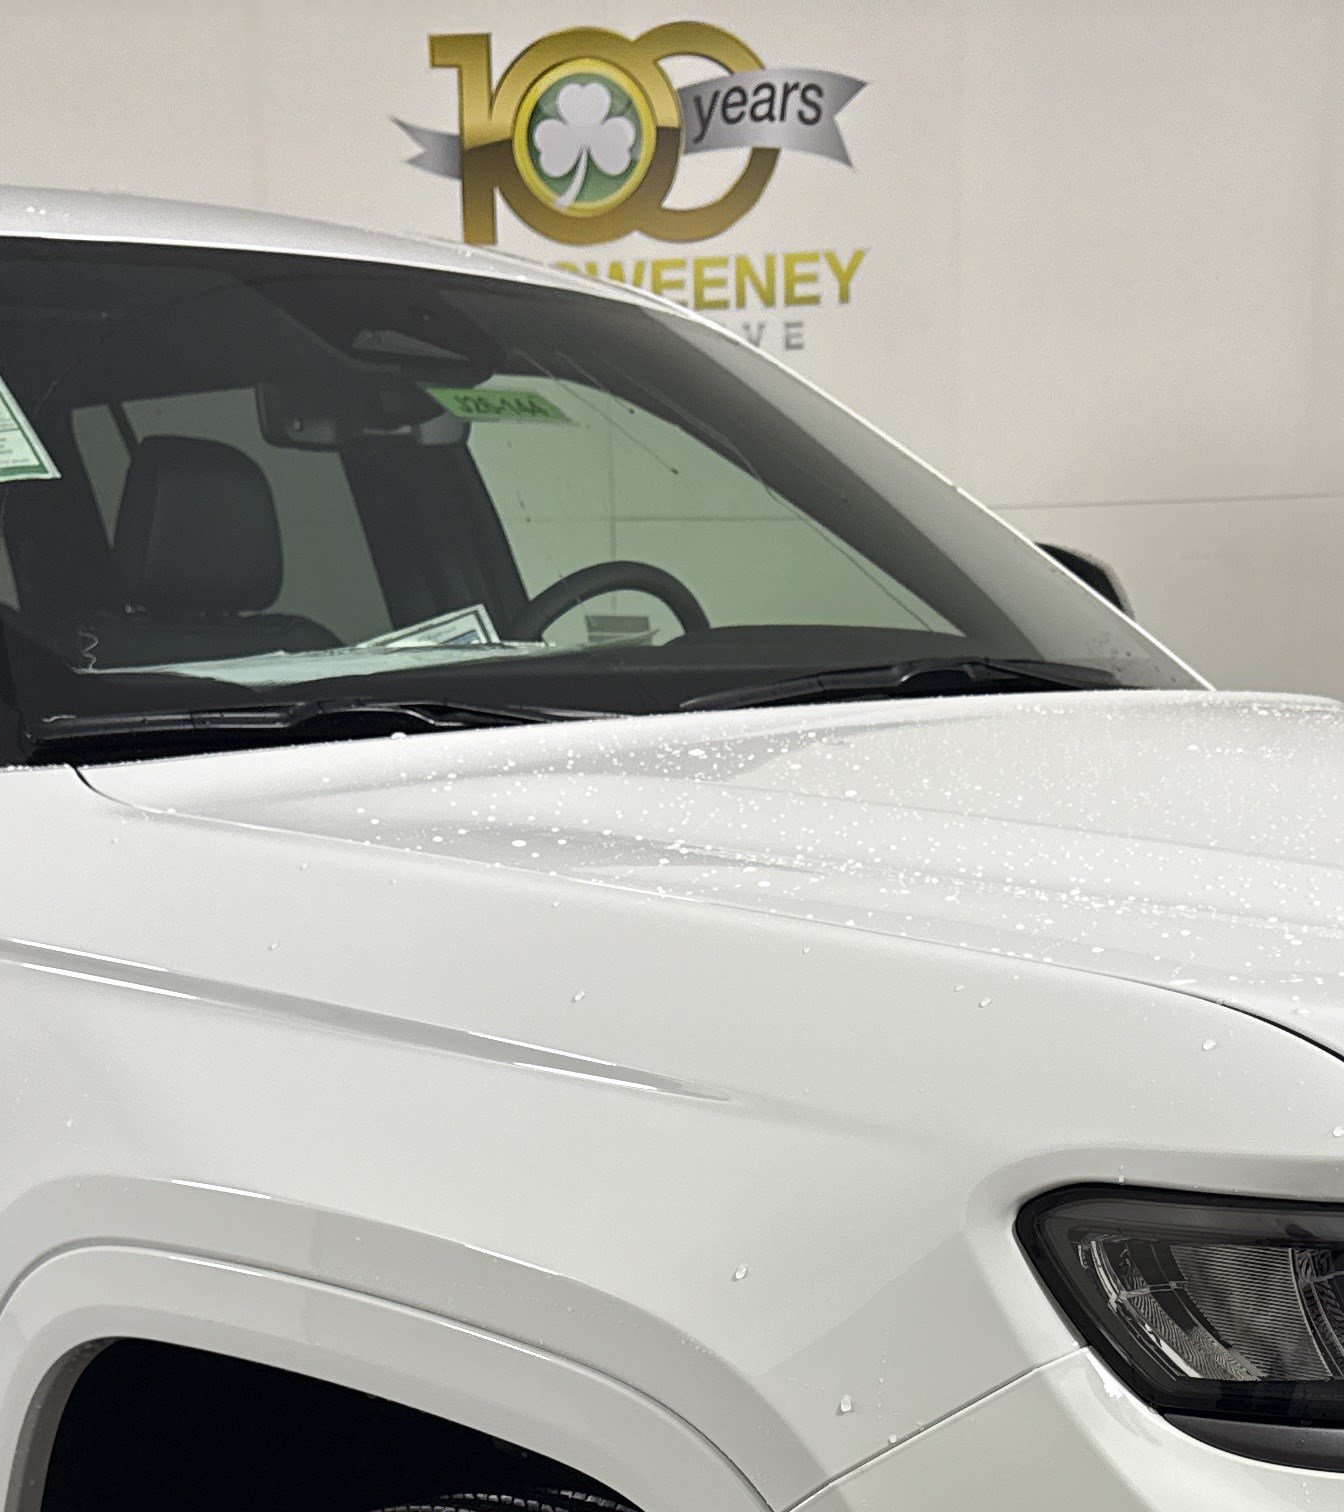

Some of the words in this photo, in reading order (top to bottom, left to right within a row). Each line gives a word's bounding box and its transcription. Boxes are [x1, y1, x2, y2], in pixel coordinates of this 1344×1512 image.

[428, 21, 780, 245] 100
[693, 79, 824, 144] years
[555, 248, 866, 310] EENEY
